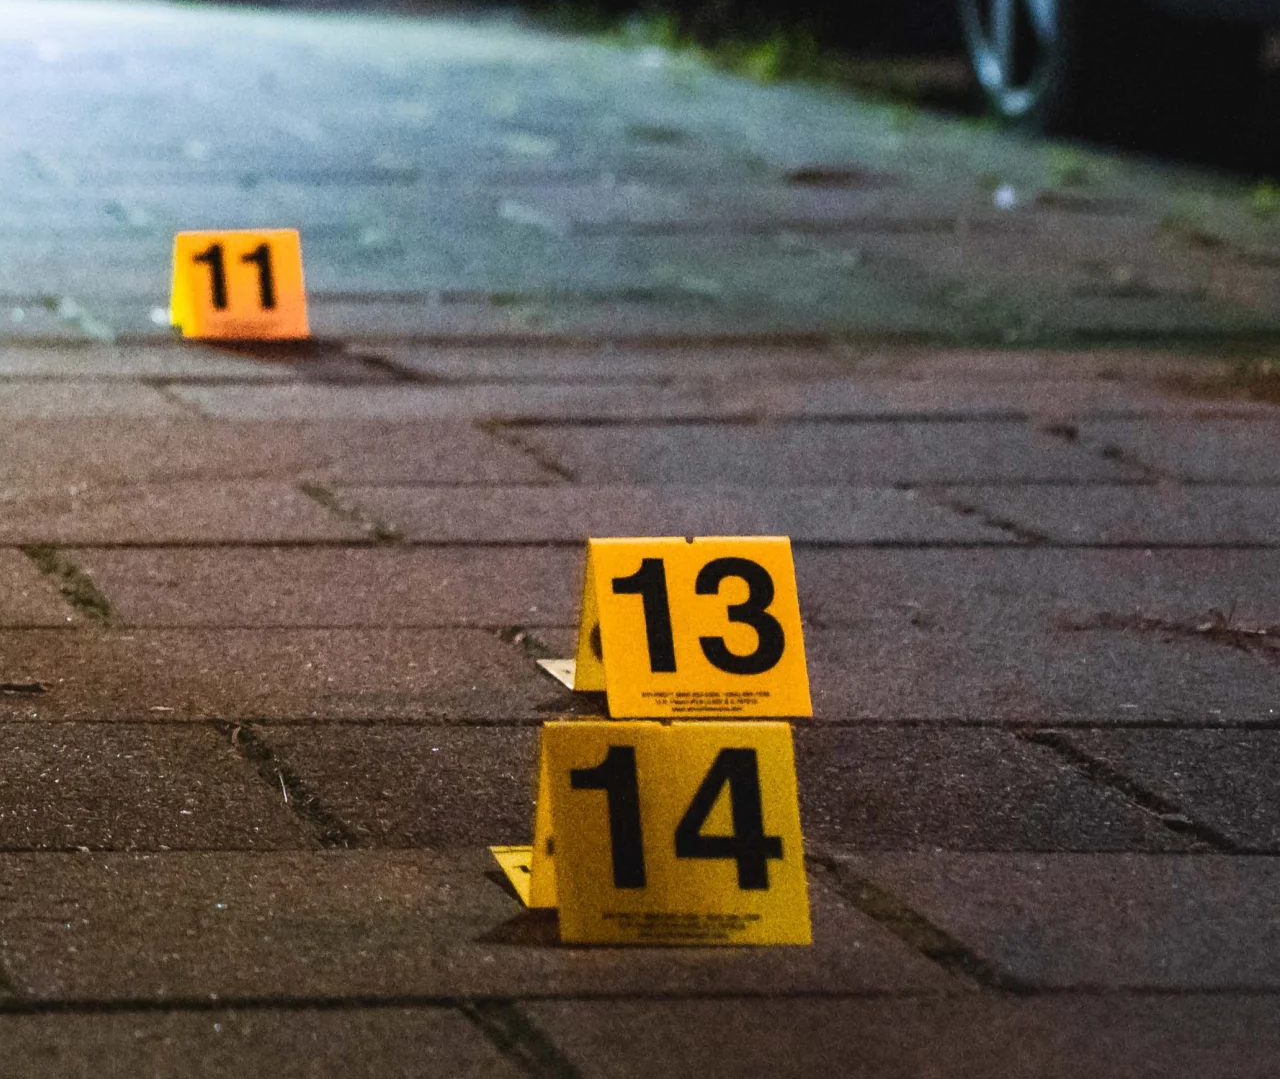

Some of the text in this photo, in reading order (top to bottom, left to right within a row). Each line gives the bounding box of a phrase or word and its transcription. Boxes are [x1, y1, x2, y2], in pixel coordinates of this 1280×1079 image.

[193, 242, 276, 311] 11
[611, 557, 786, 675] 13
[569, 745, 783, 891] 14
